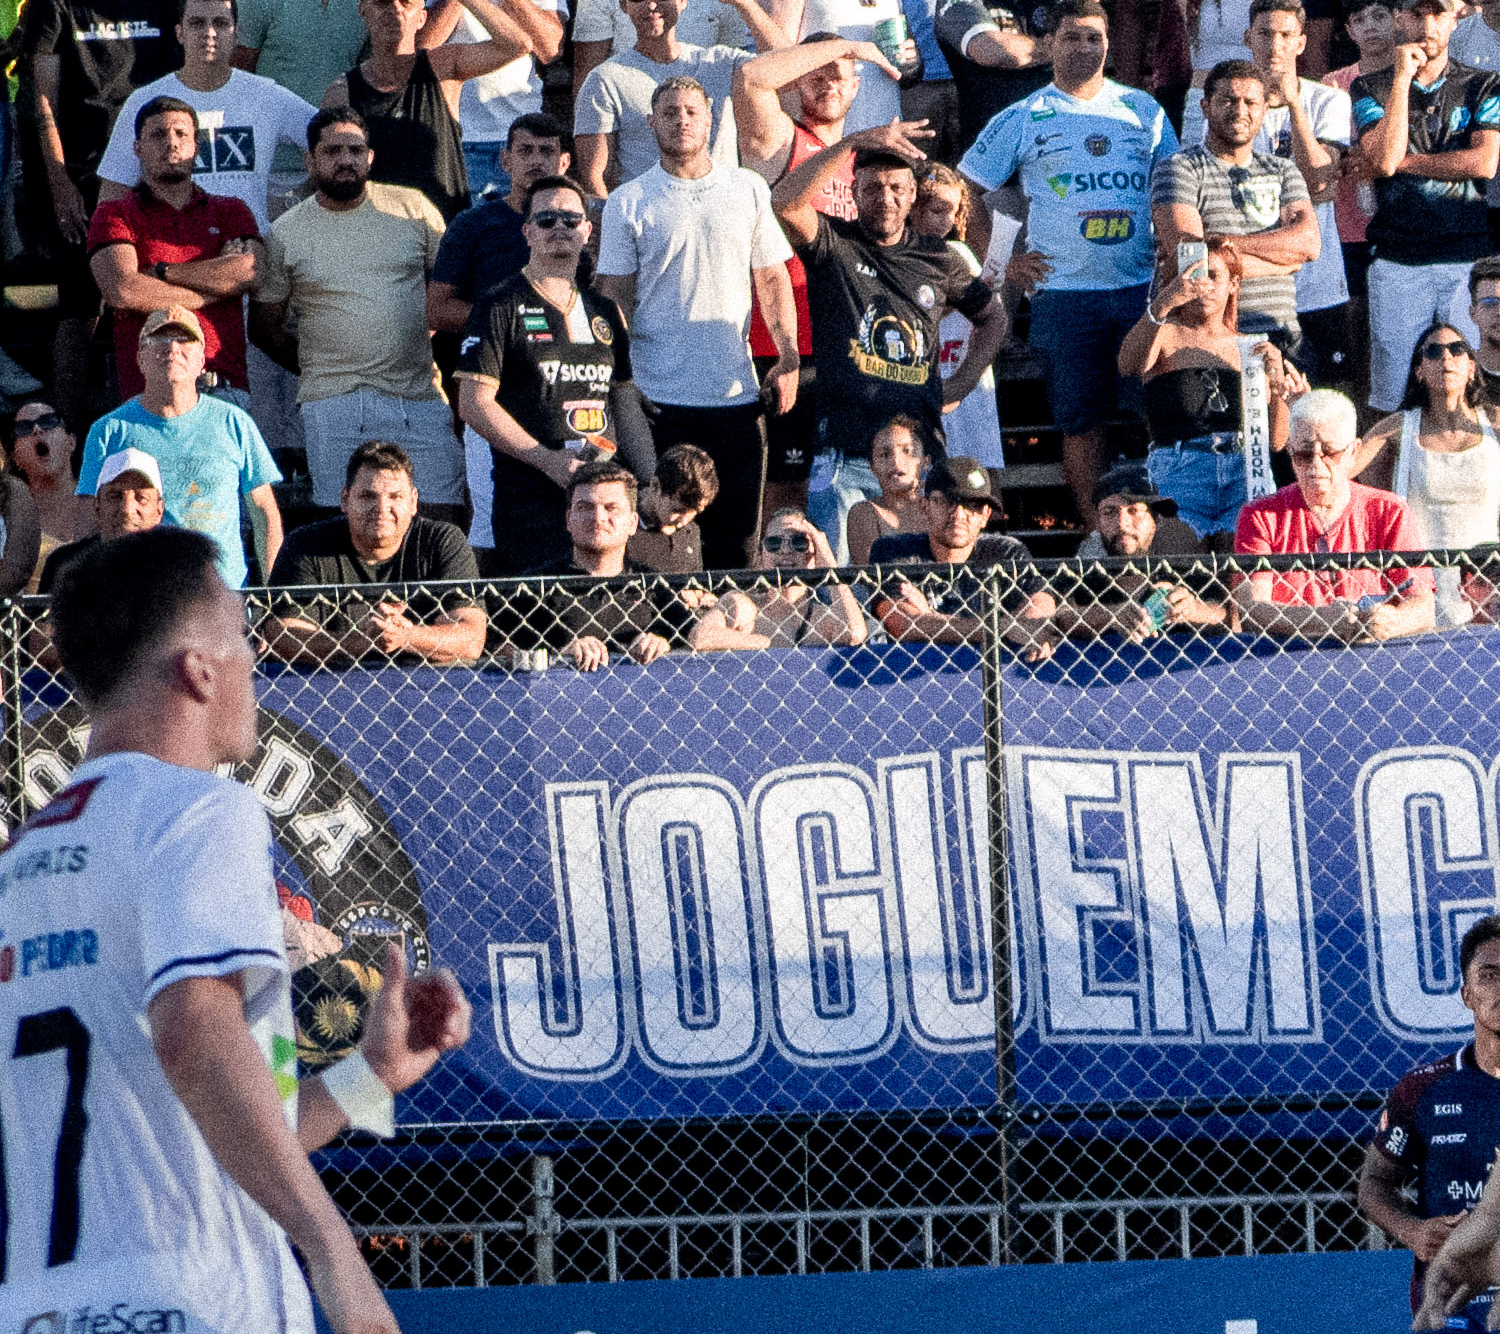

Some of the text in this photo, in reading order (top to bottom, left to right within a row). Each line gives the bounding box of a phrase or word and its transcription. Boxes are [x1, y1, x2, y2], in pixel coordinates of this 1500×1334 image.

[1085, 215, 1132, 239] BH
[488, 745, 1323, 1083] JOGUEM
[1434, 1103, 1463, 1116] EGIS
